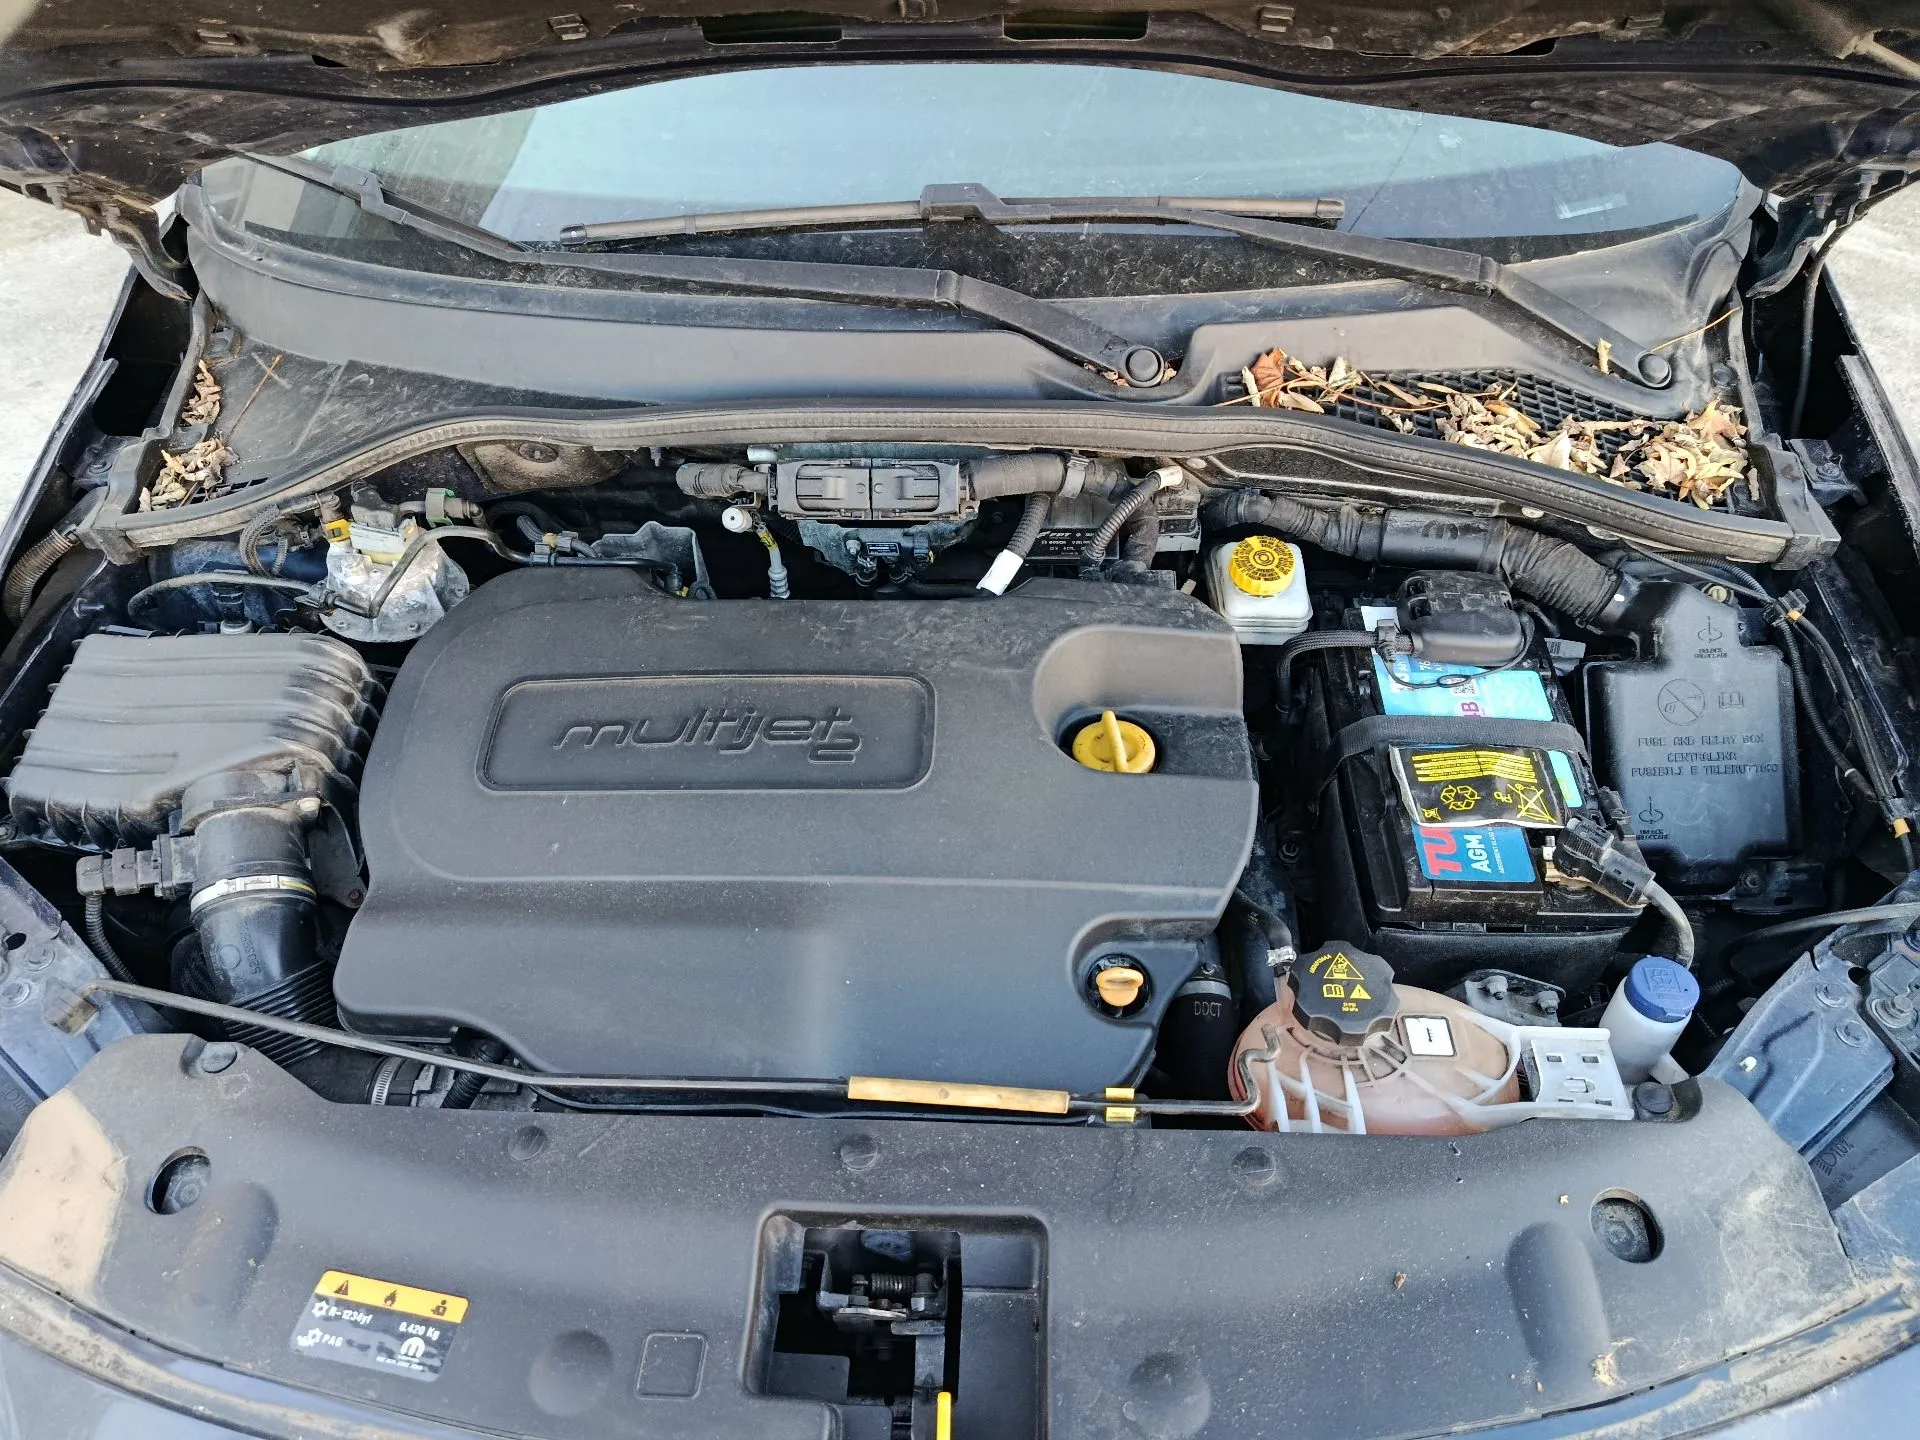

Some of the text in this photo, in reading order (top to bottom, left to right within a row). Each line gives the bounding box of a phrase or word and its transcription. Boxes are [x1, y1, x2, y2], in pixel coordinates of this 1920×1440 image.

[552, 706, 853, 753] multijet
[1638, 733, 1765, 747] FUSE AND RELAY BOX
[1667, 751, 1738, 763] CENTRALINA
[1463, 834, 1492, 874] AGM
[1194, 1000, 1222, 1018] DDCT
